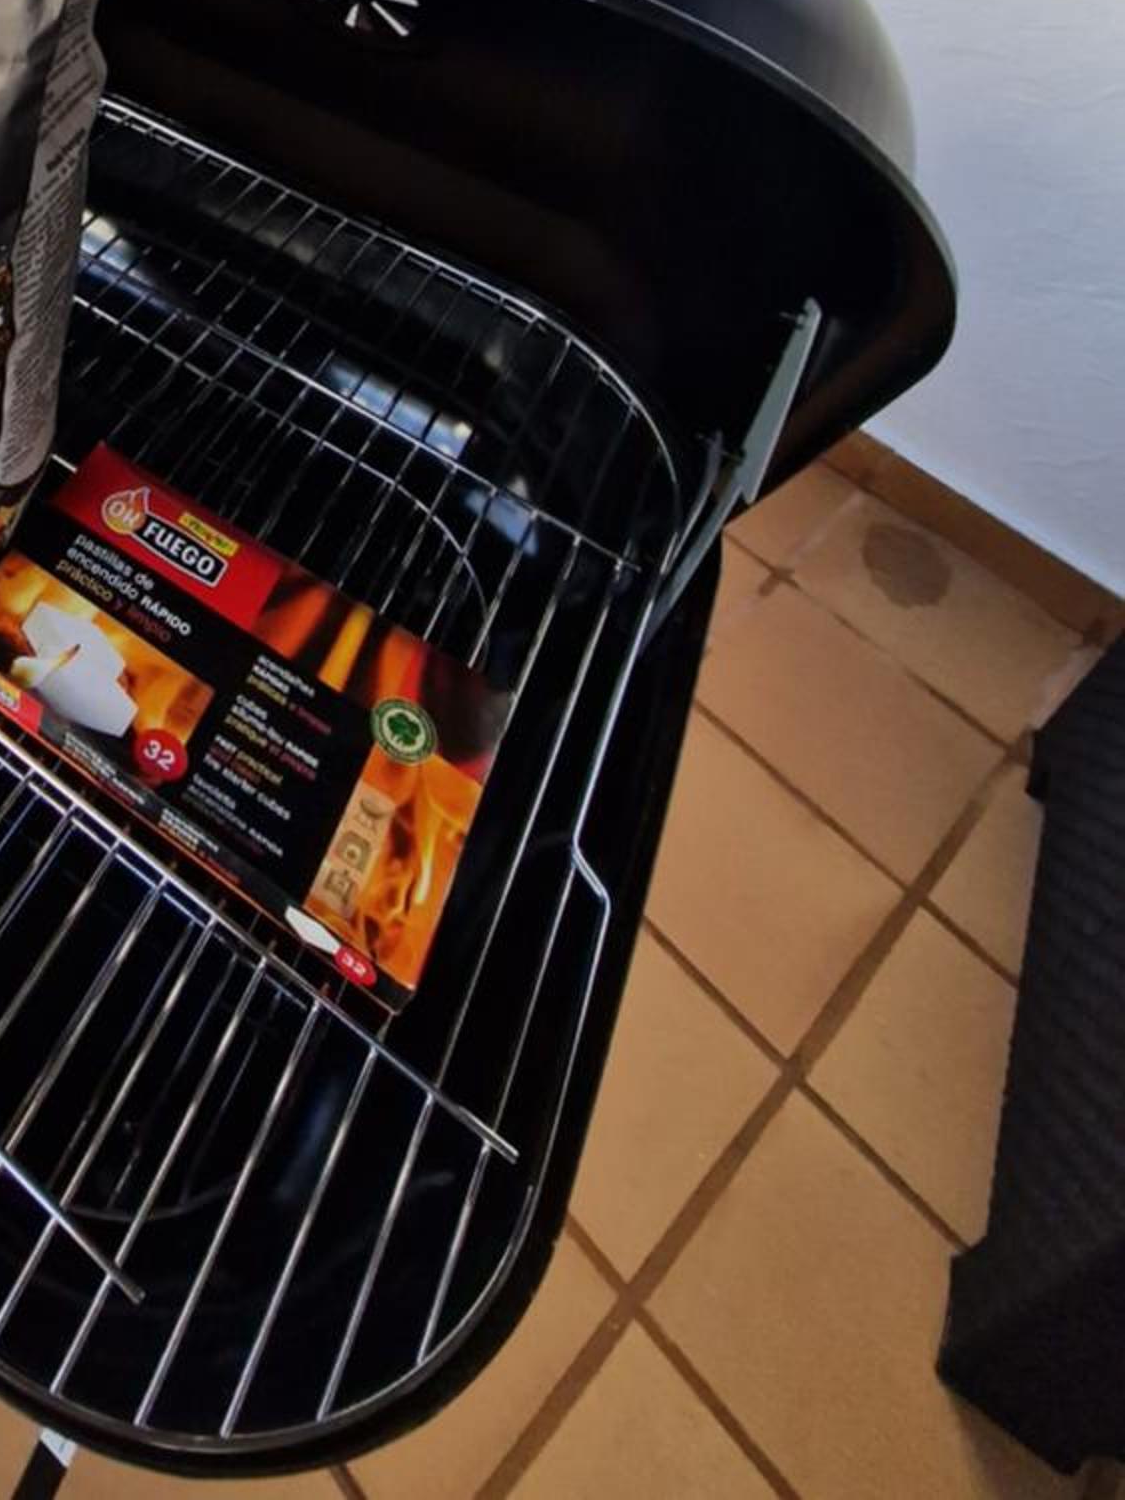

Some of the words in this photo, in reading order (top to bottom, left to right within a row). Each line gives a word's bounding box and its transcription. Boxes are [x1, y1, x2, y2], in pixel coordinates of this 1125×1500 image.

[74, 533, 134, 577] pastillas
[134, 569, 155, 591] de
[142, 521, 217, 576] FUEGO
[55, 558, 114, 602] práctico
[66, 547, 140, 601] encendido
[139, 593, 192, 636] RÁPIDO
[142, 739, 176, 772] 32
